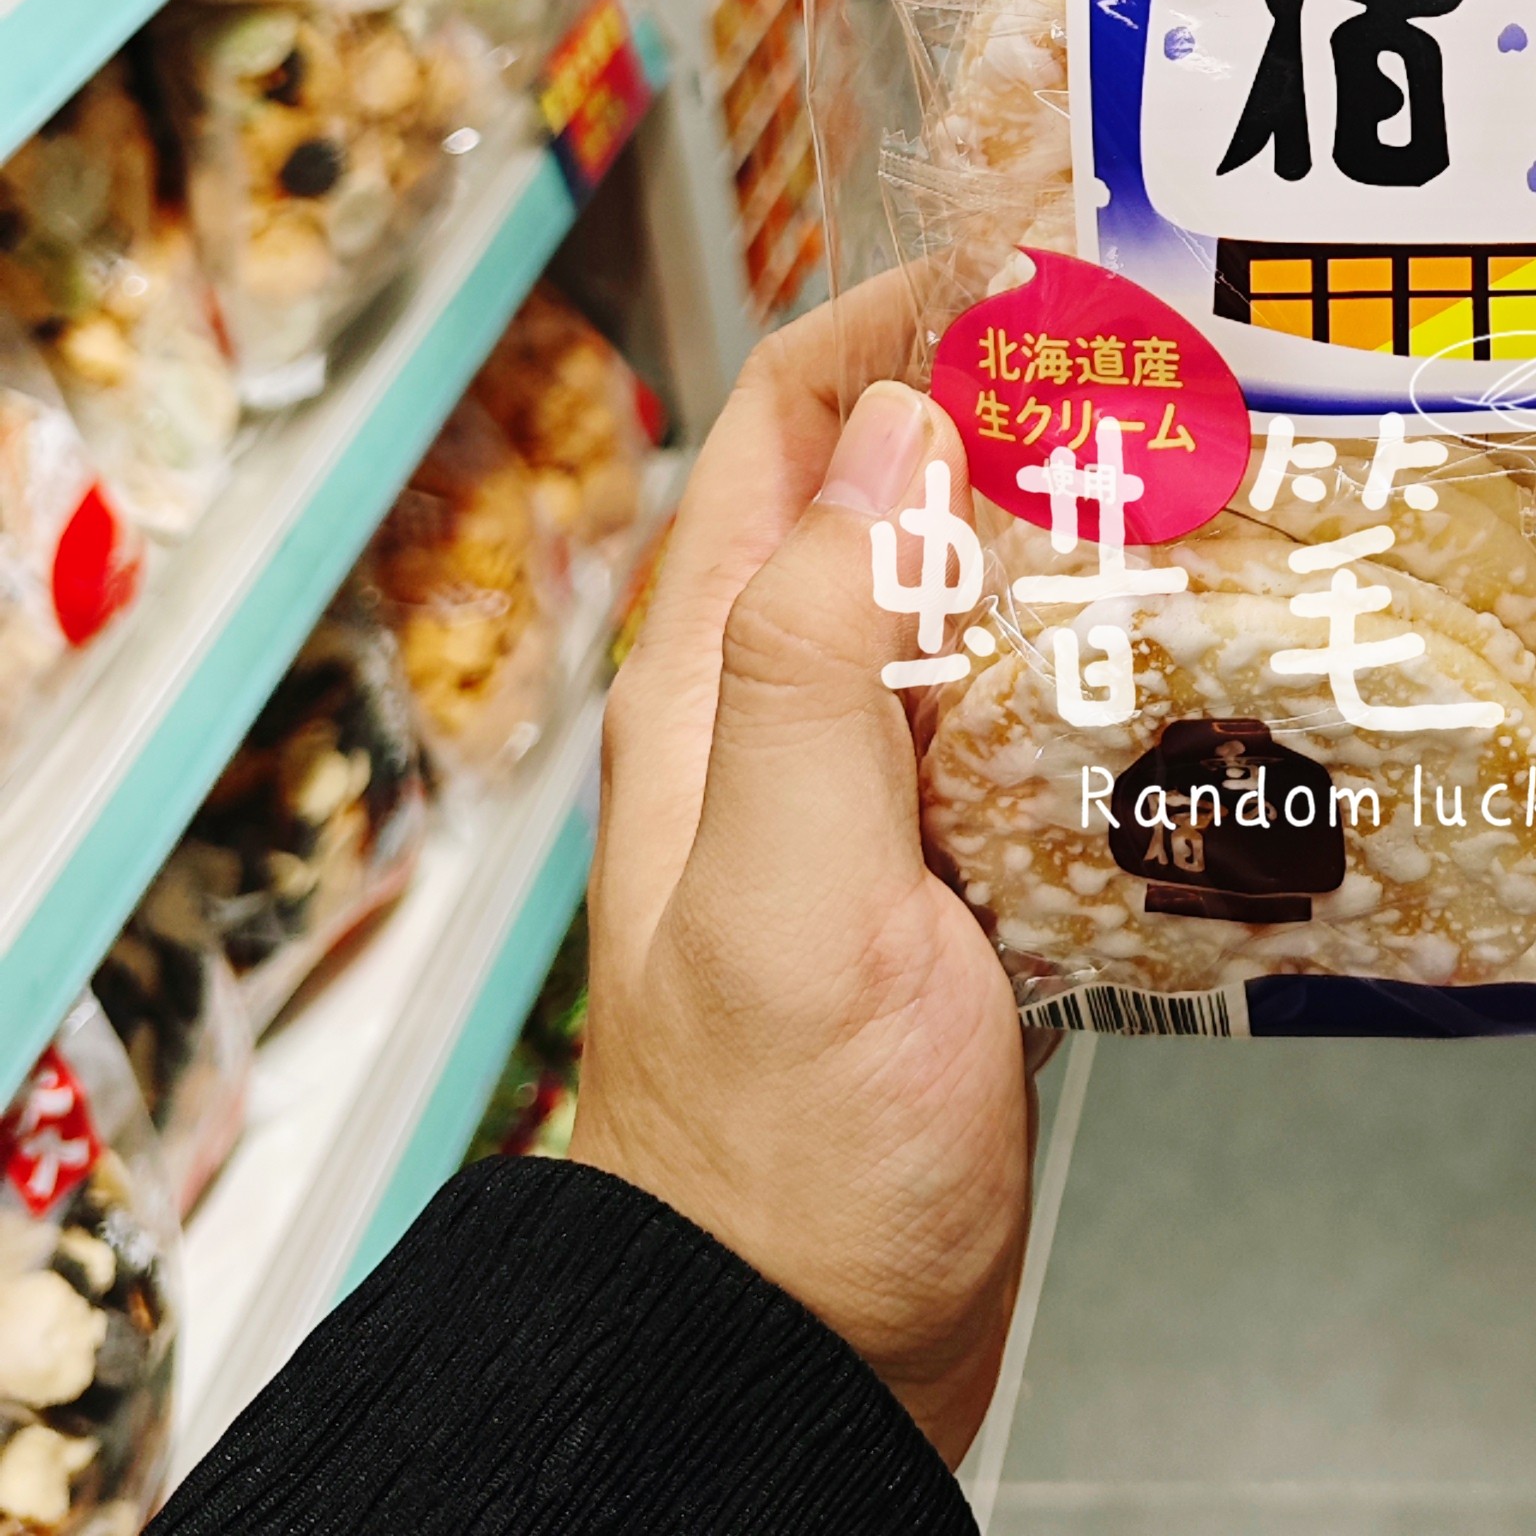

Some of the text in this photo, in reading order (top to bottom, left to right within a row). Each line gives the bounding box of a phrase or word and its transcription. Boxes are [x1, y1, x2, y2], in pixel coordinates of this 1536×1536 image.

[977, 325, 1184, 389] 北海道産
[974, 388, 1197, 453] 生クリーム
